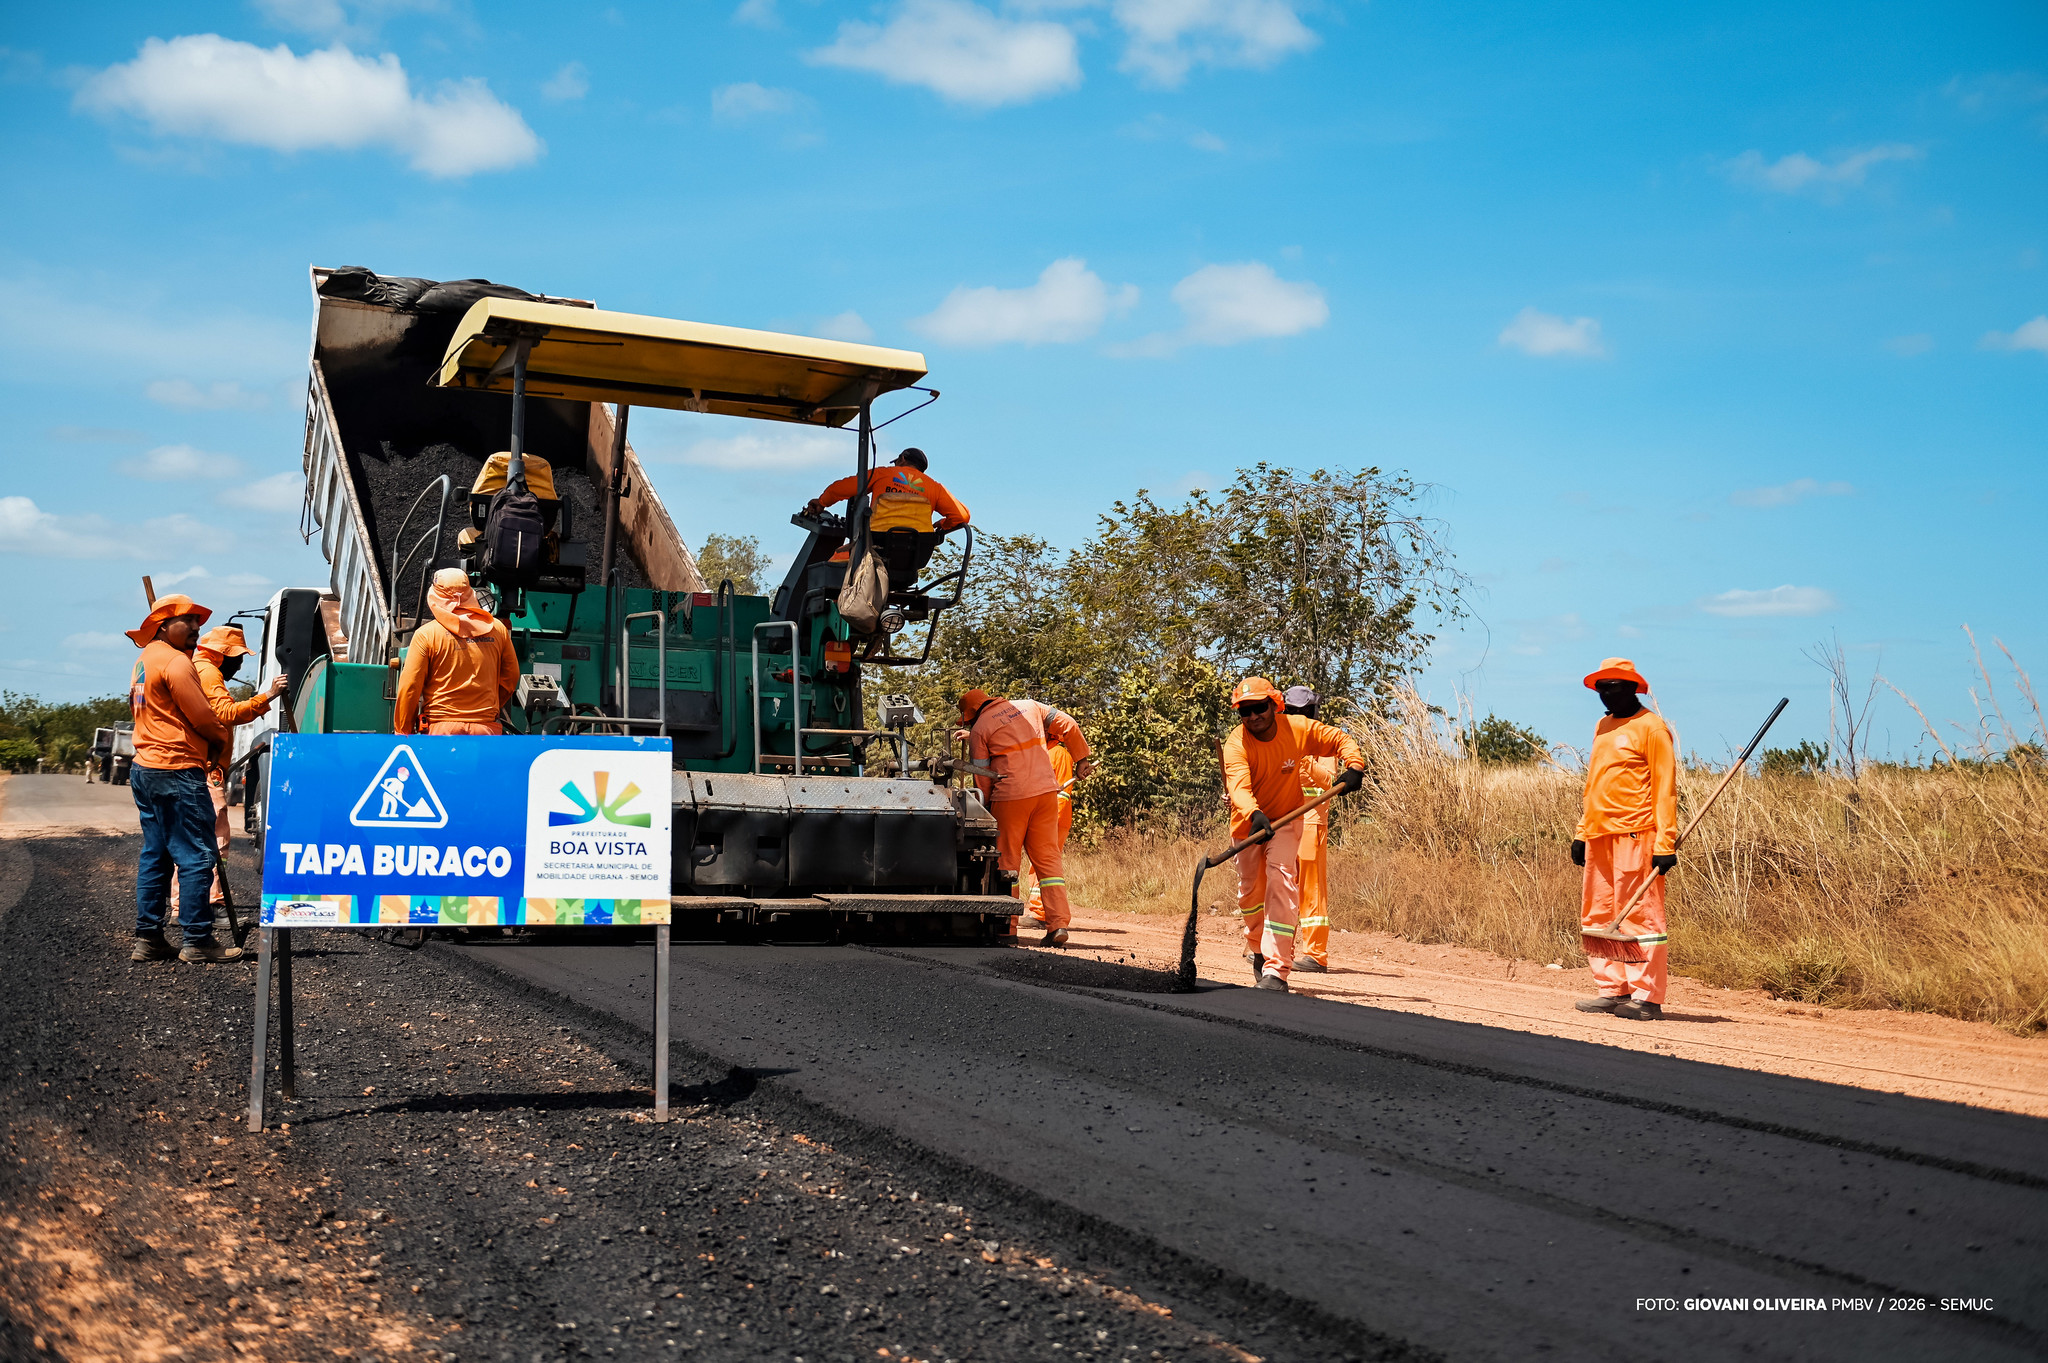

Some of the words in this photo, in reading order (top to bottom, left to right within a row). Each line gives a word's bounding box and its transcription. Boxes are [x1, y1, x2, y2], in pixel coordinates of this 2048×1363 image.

[648, 664, 698, 679] CBER
[550, 841, 589, 855] BOA
[595, 842, 647, 855] VISTA
[280, 843, 367, 875] TAPA
[372, 844, 512, 878] BURACO
